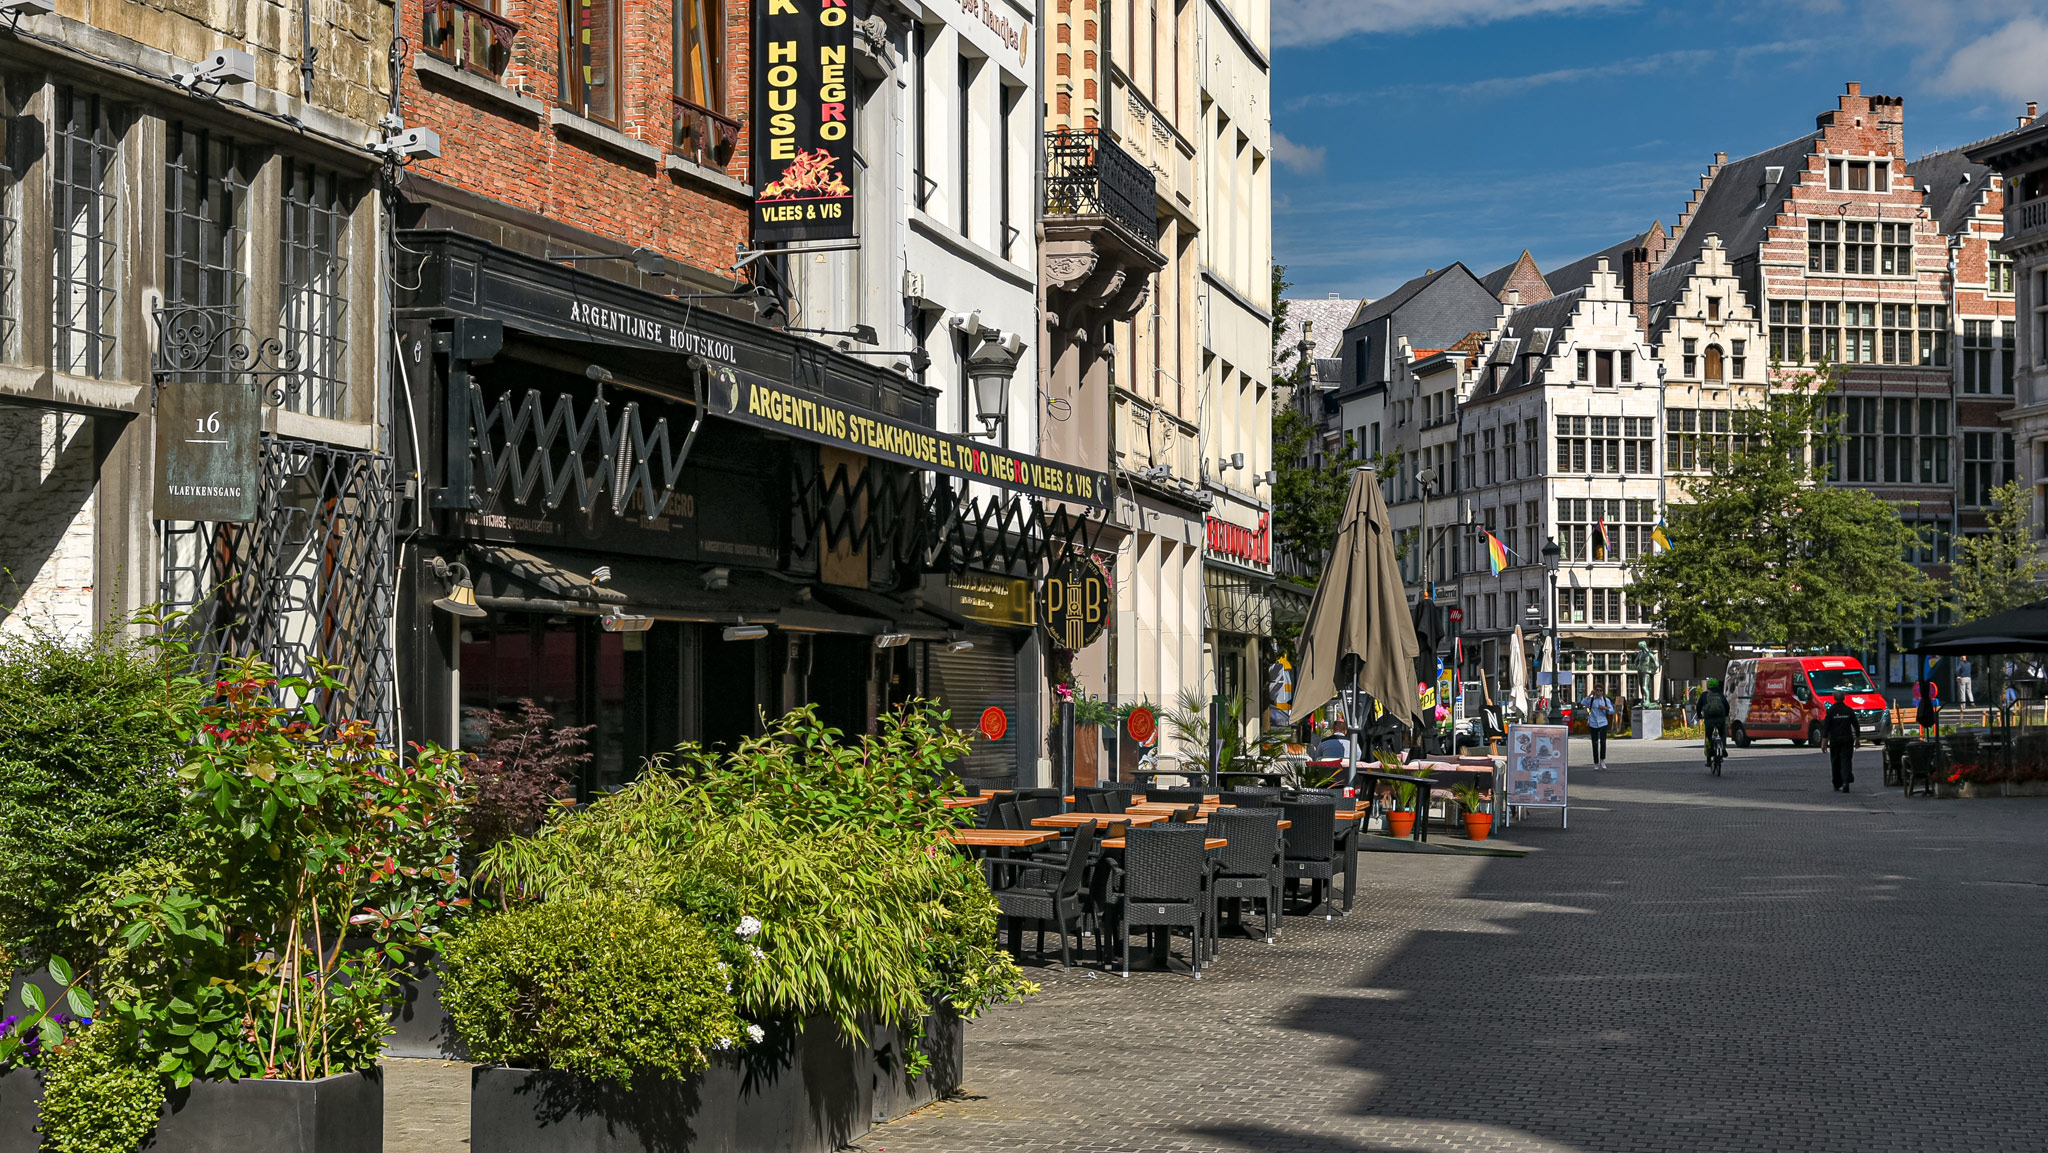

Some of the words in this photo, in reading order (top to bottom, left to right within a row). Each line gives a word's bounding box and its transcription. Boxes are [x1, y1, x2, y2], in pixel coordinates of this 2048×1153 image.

[767, 40, 798, 161] HOUSE
[819, 45, 847, 141] NEGRO
[761, 204, 803, 223] VLEES
[806, 204, 817, 220] &
[819, 202, 842, 219] VIS
[570, 301, 663, 344] ARGENTIJNSE
[669, 328, 737, 364] HOUTSKOOL
[195, 410, 221, 434] 16
[748, 383, 847, 440] ARGENTIJNS
[849, 414, 938, 464] STEAKHOUSE
[939, 440, 956, 468] EL
[956, 444, 989, 476] TORO
[990, 453, 1029, 485] NEGRO
[1030, 463, 1064, 493] VLEES
[1065, 471, 1074, 495] &
[1075, 473, 1093, 499] VIS
[168, 485, 242, 498] VLAEYKENSGANG
[1047, 578, 1063, 624] P
[1085, 577, 1101, 623] B
[1450, 610, 1462, 621] illy
